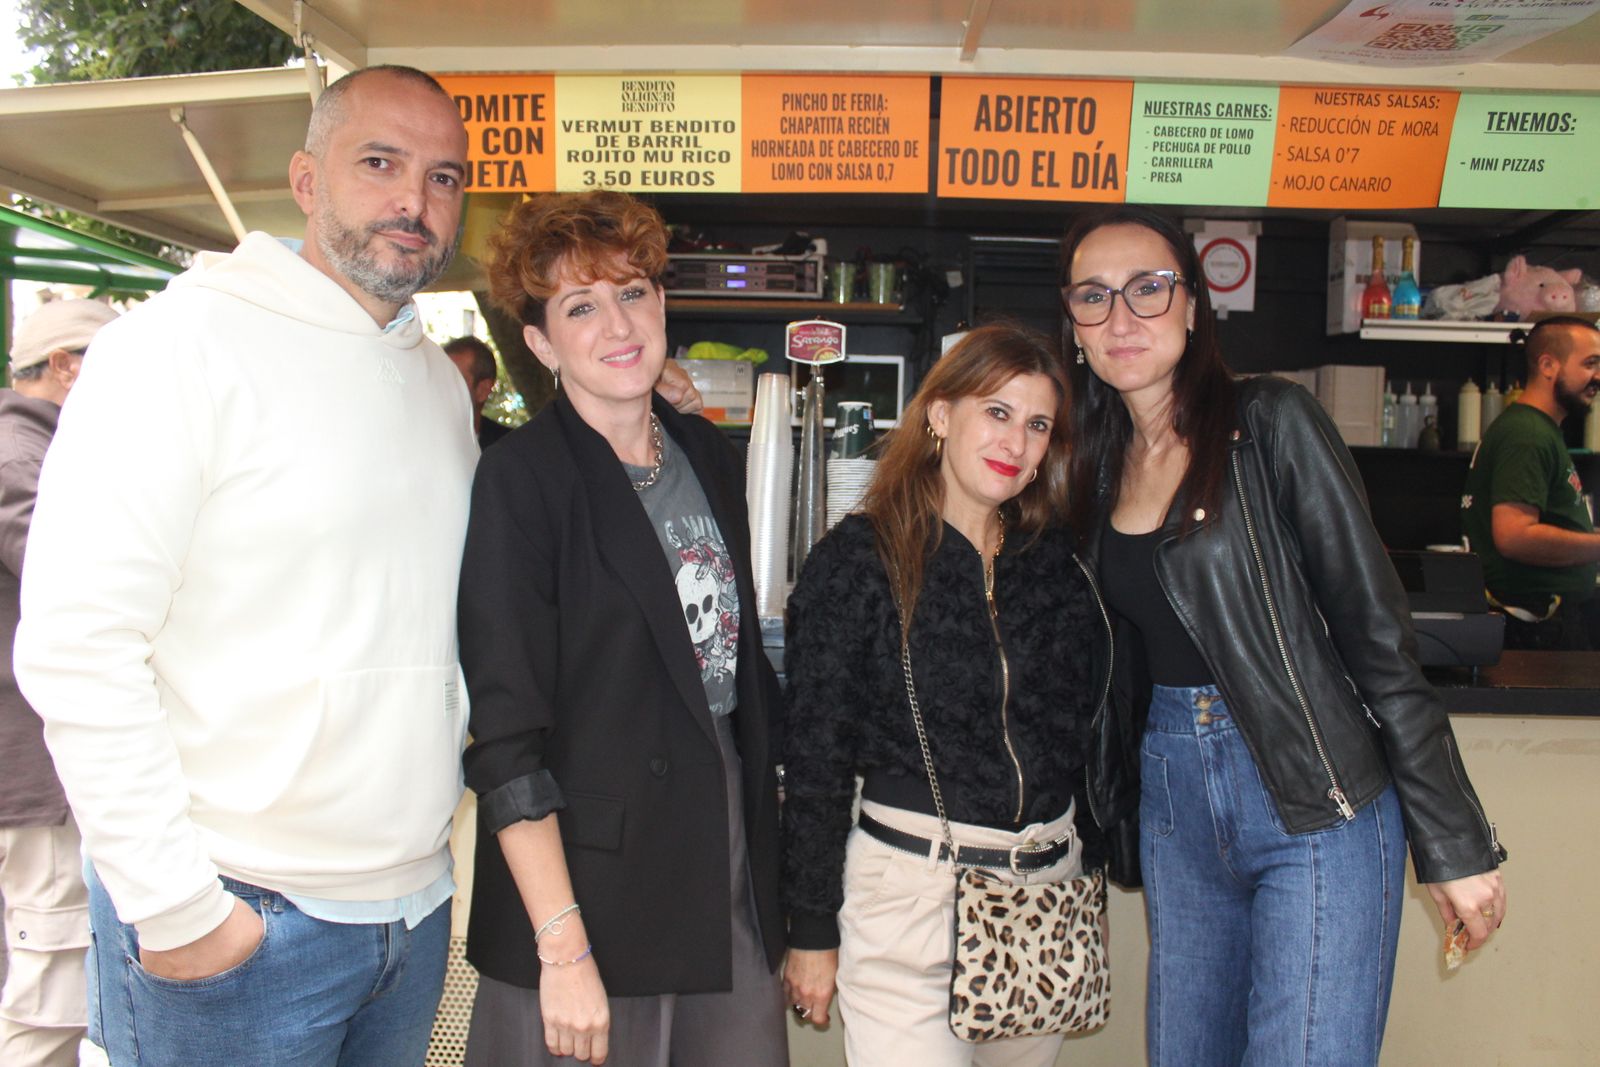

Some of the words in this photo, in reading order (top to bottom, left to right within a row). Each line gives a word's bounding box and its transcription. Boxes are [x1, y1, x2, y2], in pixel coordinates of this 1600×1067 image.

[622, 81, 674, 91] BENDITO
[453, 94, 546, 122] DMITE
[623, 102, 674, 112] BENDITO
[782, 93, 827, 111] PINCHO
[832, 94, 847, 111] DE
[852, 94, 888, 112] FERIA:
[1315, 92, 1380, 107] NUESTRAS
[1387, 94, 1440, 109] SALSAS:
[974, 94, 1096, 135] ABIERTO
[1144, 101, 1211, 117] NUESTRAS
[1215, 103, 1273, 119] CARNES:
[562, 120, 642, 133] VERMUT
[651, 120, 735, 133] BENDITO
[781, 117, 843, 134] CHAPATITA
[848, 111, 889, 134] RECIÉN
[1290, 115, 1370, 135] REDUCCIÓN
[1378, 120, 1396, 136] DE
[1402, 121, 1438, 136] MORA
[1487, 112, 1576, 131] TENEMOS:
[482, 127, 543, 155] CON
[1154, 126, 1206, 138] CABECERO
[1210, 128, 1222, 138] DE
[1226, 128, 1253, 139] LOMO
[596, 136, 619, 147] DE
[628, 136, 701, 148] BARRIL
[752, 140, 815, 157] HORNEADA
[820, 140, 833, 157] DE
[838, 140, 899, 158] CABECERO
[904, 140, 918, 158] DE
[1153, 141, 1199, 153] PECHUGA
[1204, 143, 1216, 153] DE
[1220, 144, 1251, 155] POLLO
[568, 150, 635, 162] ROJITO
[644, 151, 673, 163] MU
[682, 151, 730, 163] RICO
[1152, 157, 1213, 168] CARRILLERA
[1287, 146, 1330, 162] SALSA
[772, 163, 804, 180] LOMO
[809, 163, 832, 180] CON
[837, 163, 872, 180] SALSA
[877, 163, 894, 182] 0,7
[946, 148, 1020, 186] TODO
[1032, 151, 1060, 188] EL
[1071, 141, 1118, 190] DÍA
[1470, 158, 1498, 170] MINI
[1502, 159, 1544, 172] PIZZAS
[464, 160, 528, 188] JETA
[641, 171, 714, 186] EUROS
[1151, 172, 1182, 183] PRESA
[1283, 175, 1324, 191] MOJO
[1330, 176, 1391, 192] CANARIO
